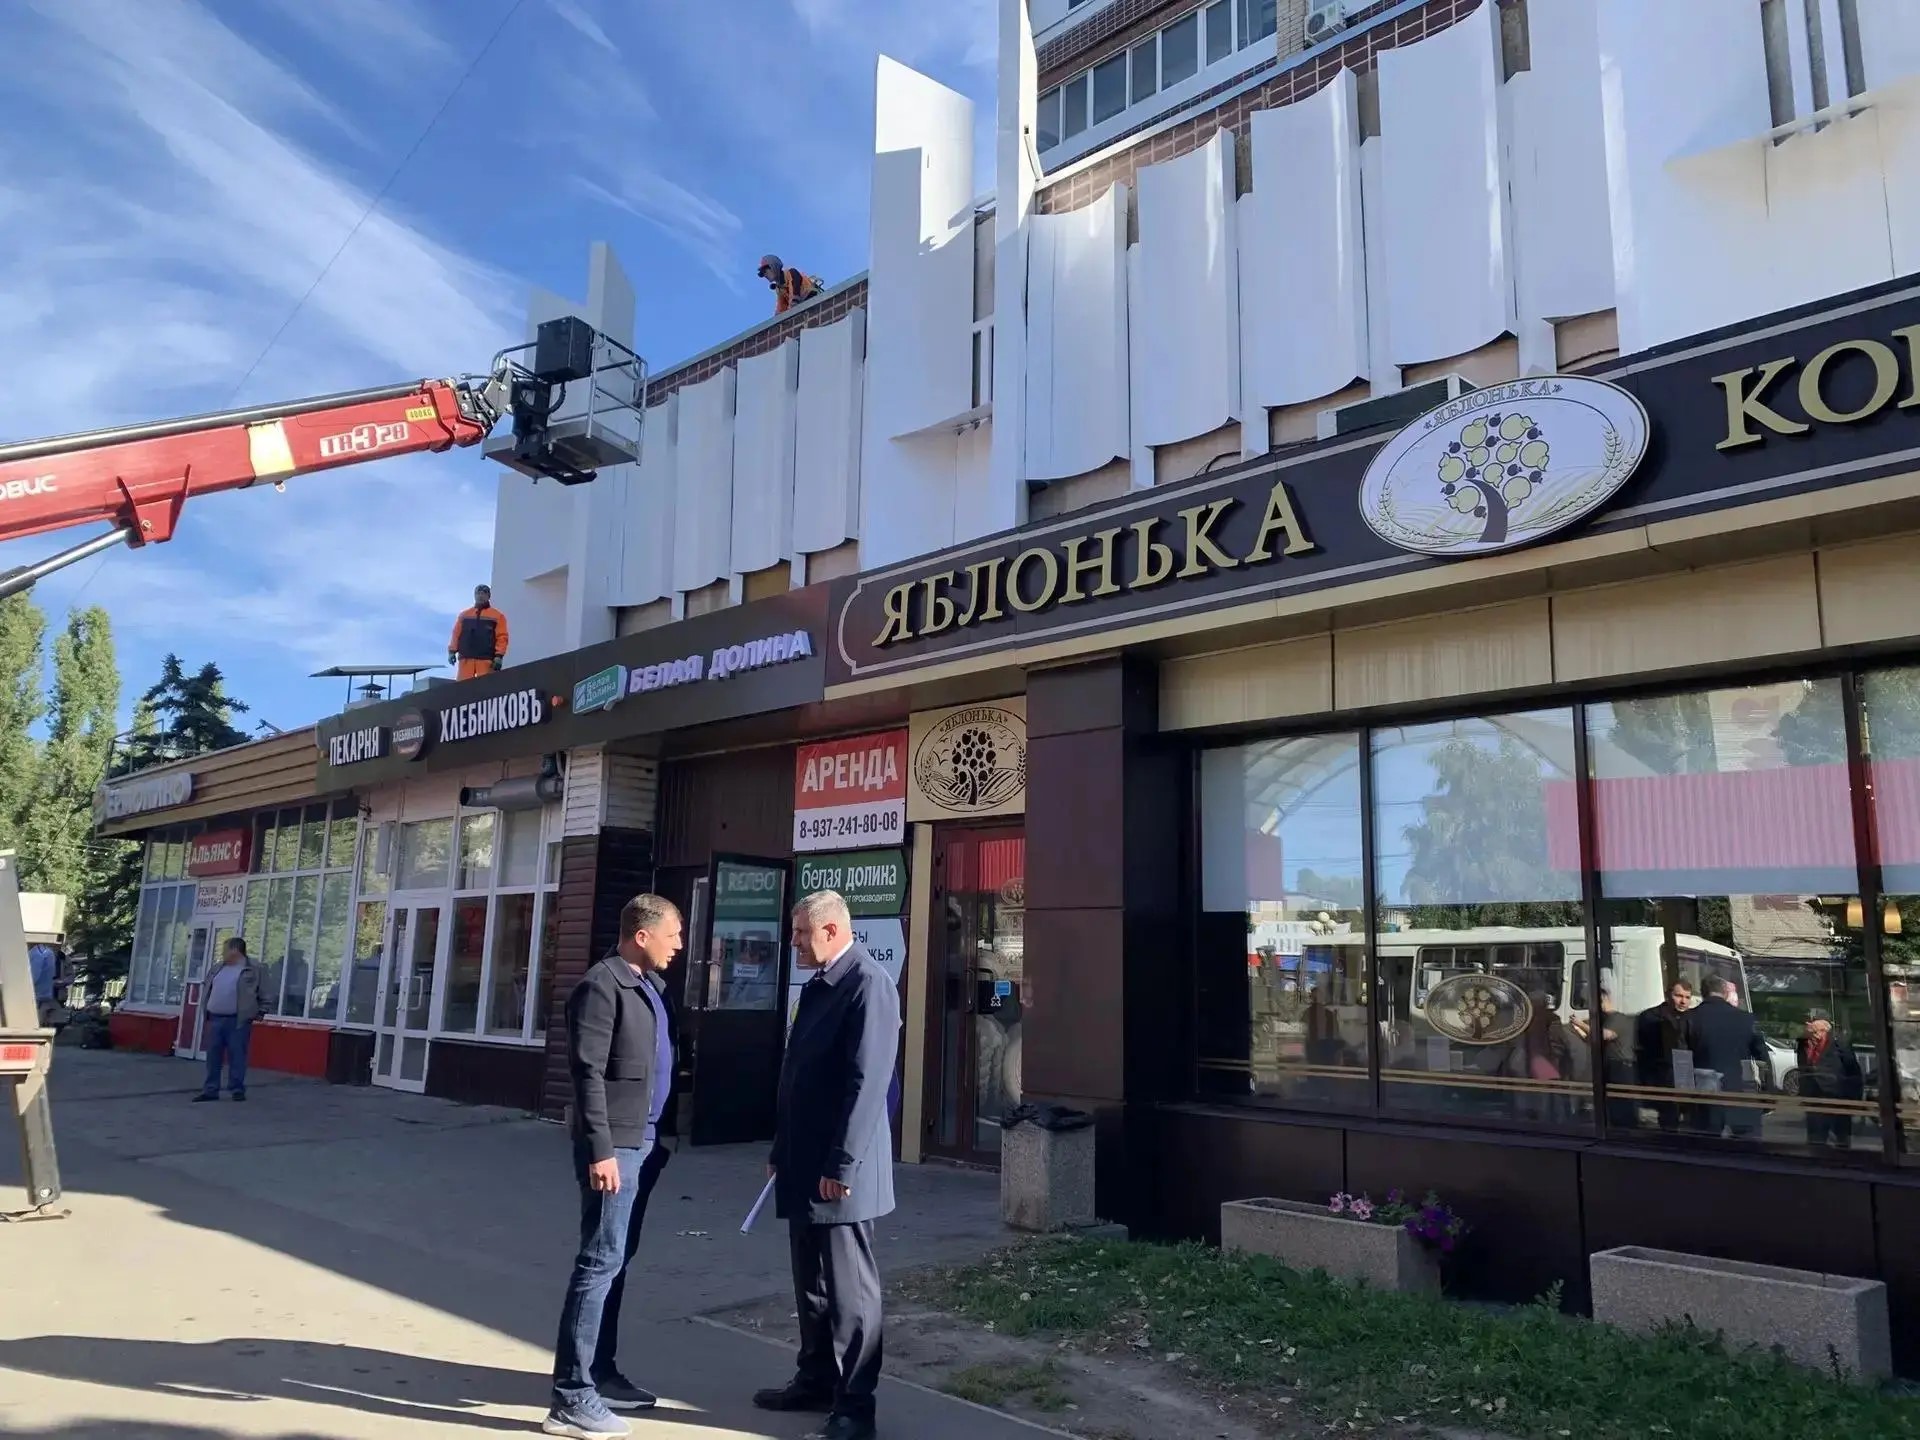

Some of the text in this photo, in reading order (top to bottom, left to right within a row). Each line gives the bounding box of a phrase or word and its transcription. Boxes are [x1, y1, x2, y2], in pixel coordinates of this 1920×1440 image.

[871, 480, 1316, 648] ЯБЛОНЬКА
[629, 629, 812, 693] БЕЛАЯ ДОЛИНА
[440, 688, 542, 743] ХЛЕБНИКОВЪ
[329, 726, 380, 766] ПЕКАРНЯ
[802, 746, 898, 792] АРЕНДА
[800, 811, 898, 839] 8-937-241-80-08
[191, 840, 242, 865] АЛЬЯНС С
[801, 863, 897, 891] белая долина
